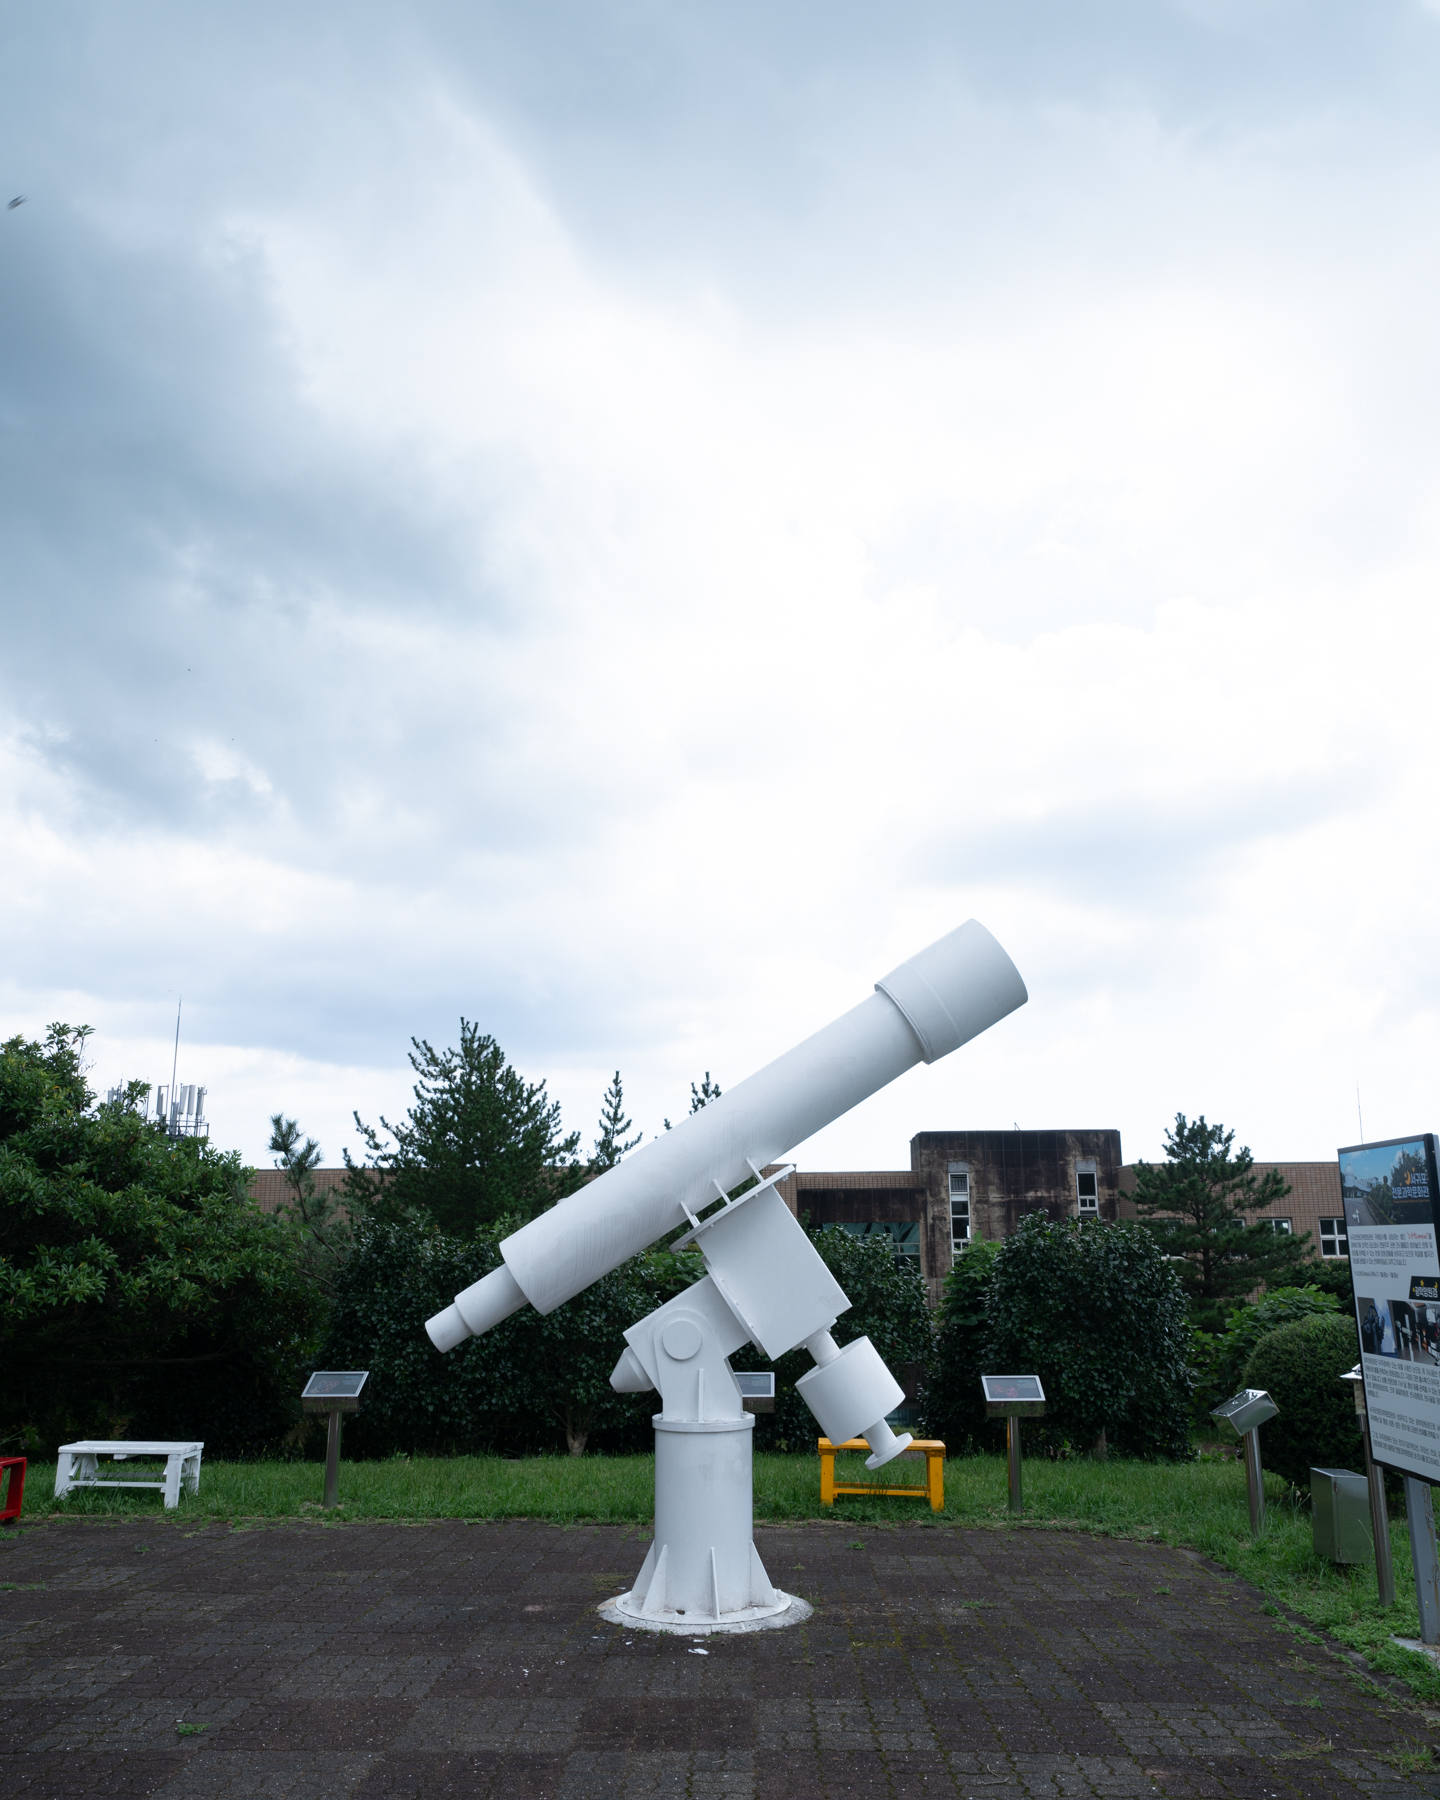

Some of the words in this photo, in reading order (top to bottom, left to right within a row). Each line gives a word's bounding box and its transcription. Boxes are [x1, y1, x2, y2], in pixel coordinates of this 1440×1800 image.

[1411, 1172, 1427, 1184] 서귀포
[1392, 1186, 1430, 1199] 천문과학문화관
[1415, 1286, 1438, 1299] 광학망원경
